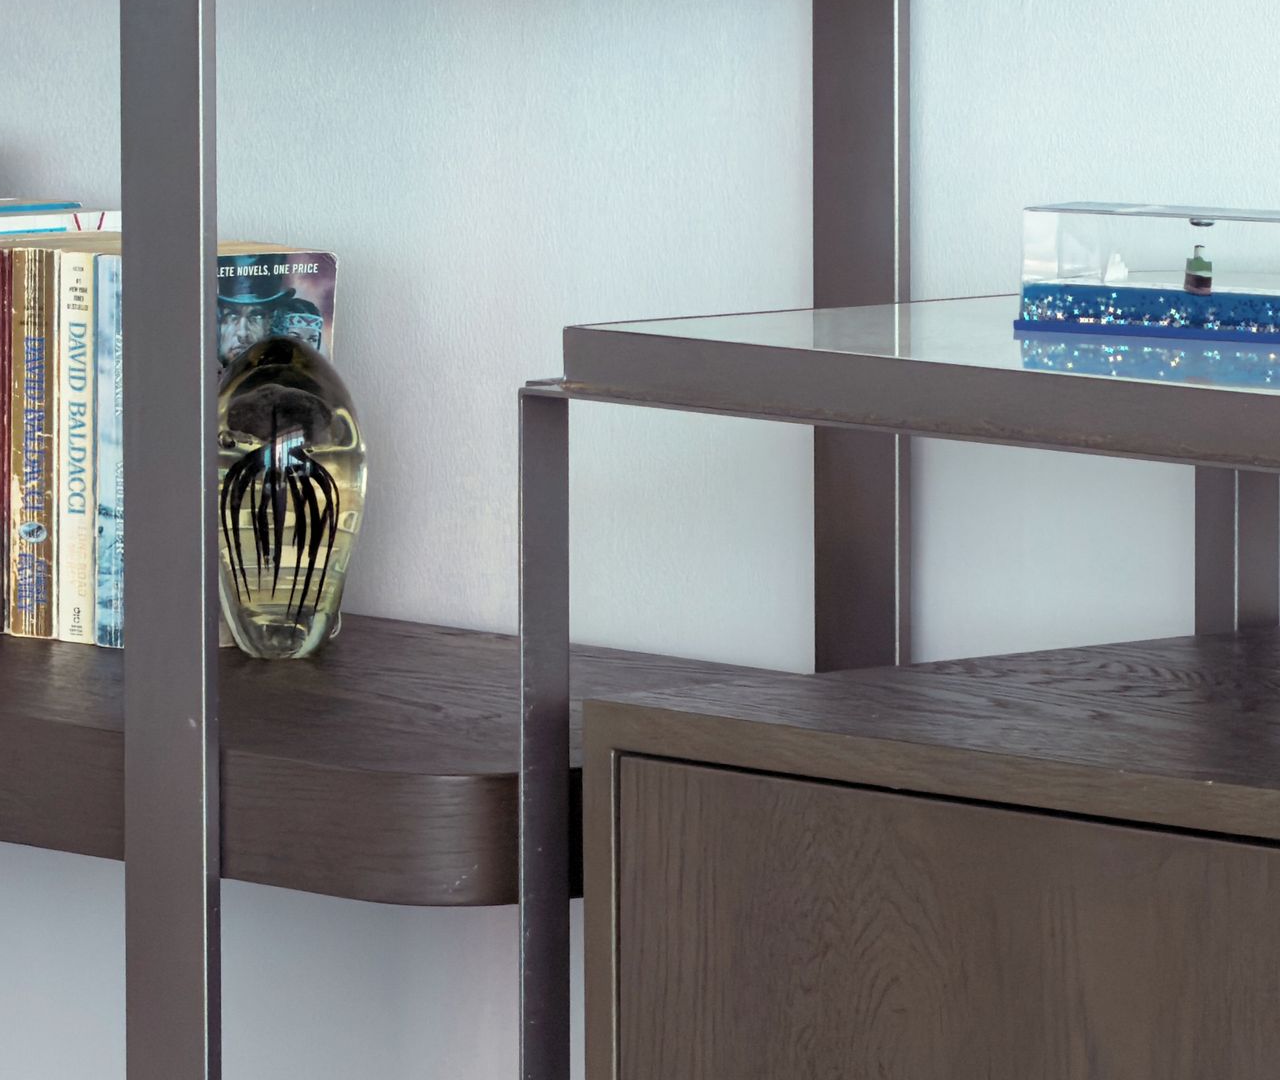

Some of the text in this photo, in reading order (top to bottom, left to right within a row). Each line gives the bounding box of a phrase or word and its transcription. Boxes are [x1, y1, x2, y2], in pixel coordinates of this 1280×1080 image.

[237, 265, 271, 277] NOVELS,
[273, 264, 290, 275] ONE
[292, 263, 319, 274] PRICE
[24, 336, 45, 401] DAVID
[68, 322, 87, 516] DAVID BALDACCI
